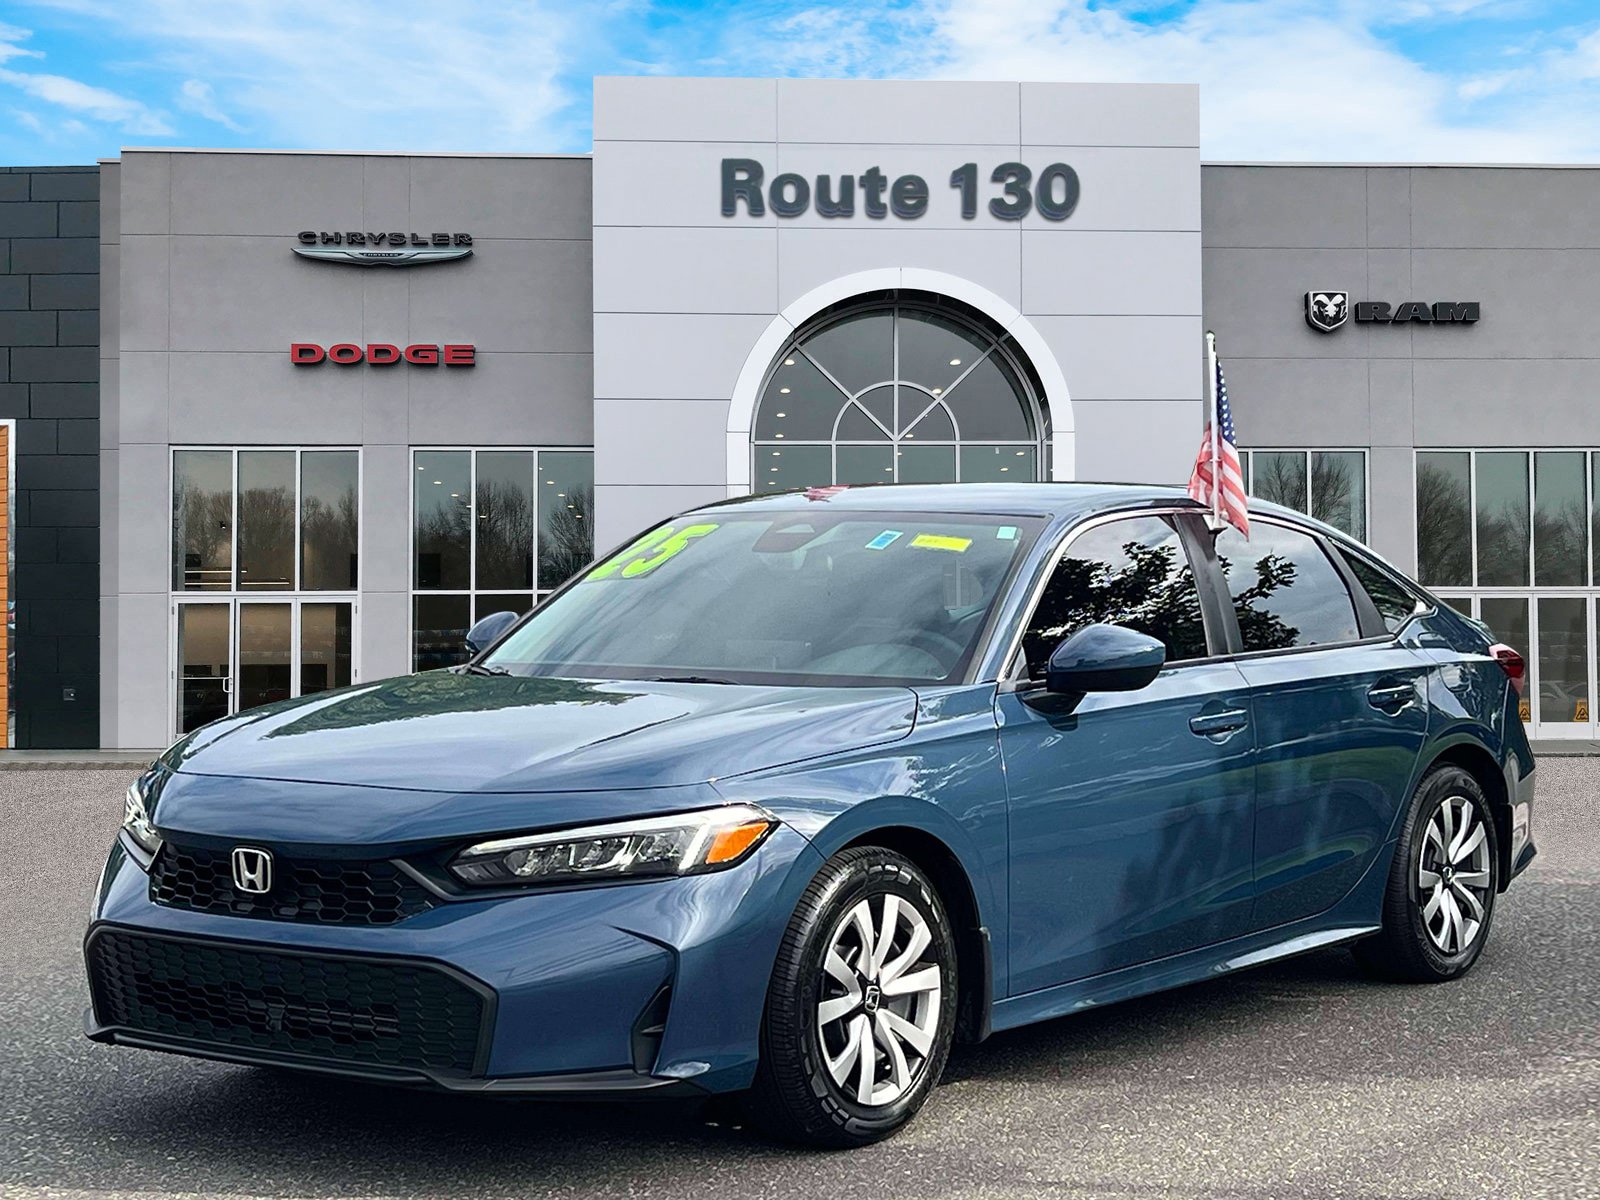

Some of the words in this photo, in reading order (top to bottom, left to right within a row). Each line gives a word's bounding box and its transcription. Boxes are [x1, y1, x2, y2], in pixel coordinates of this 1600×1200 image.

[721, 158, 929, 219] Route
[950, 161, 1080, 221] 130
[298, 231, 472, 245] CHRYSLER
[1355, 302, 1480, 323] RAM
[291, 343, 476, 366] DODGE
